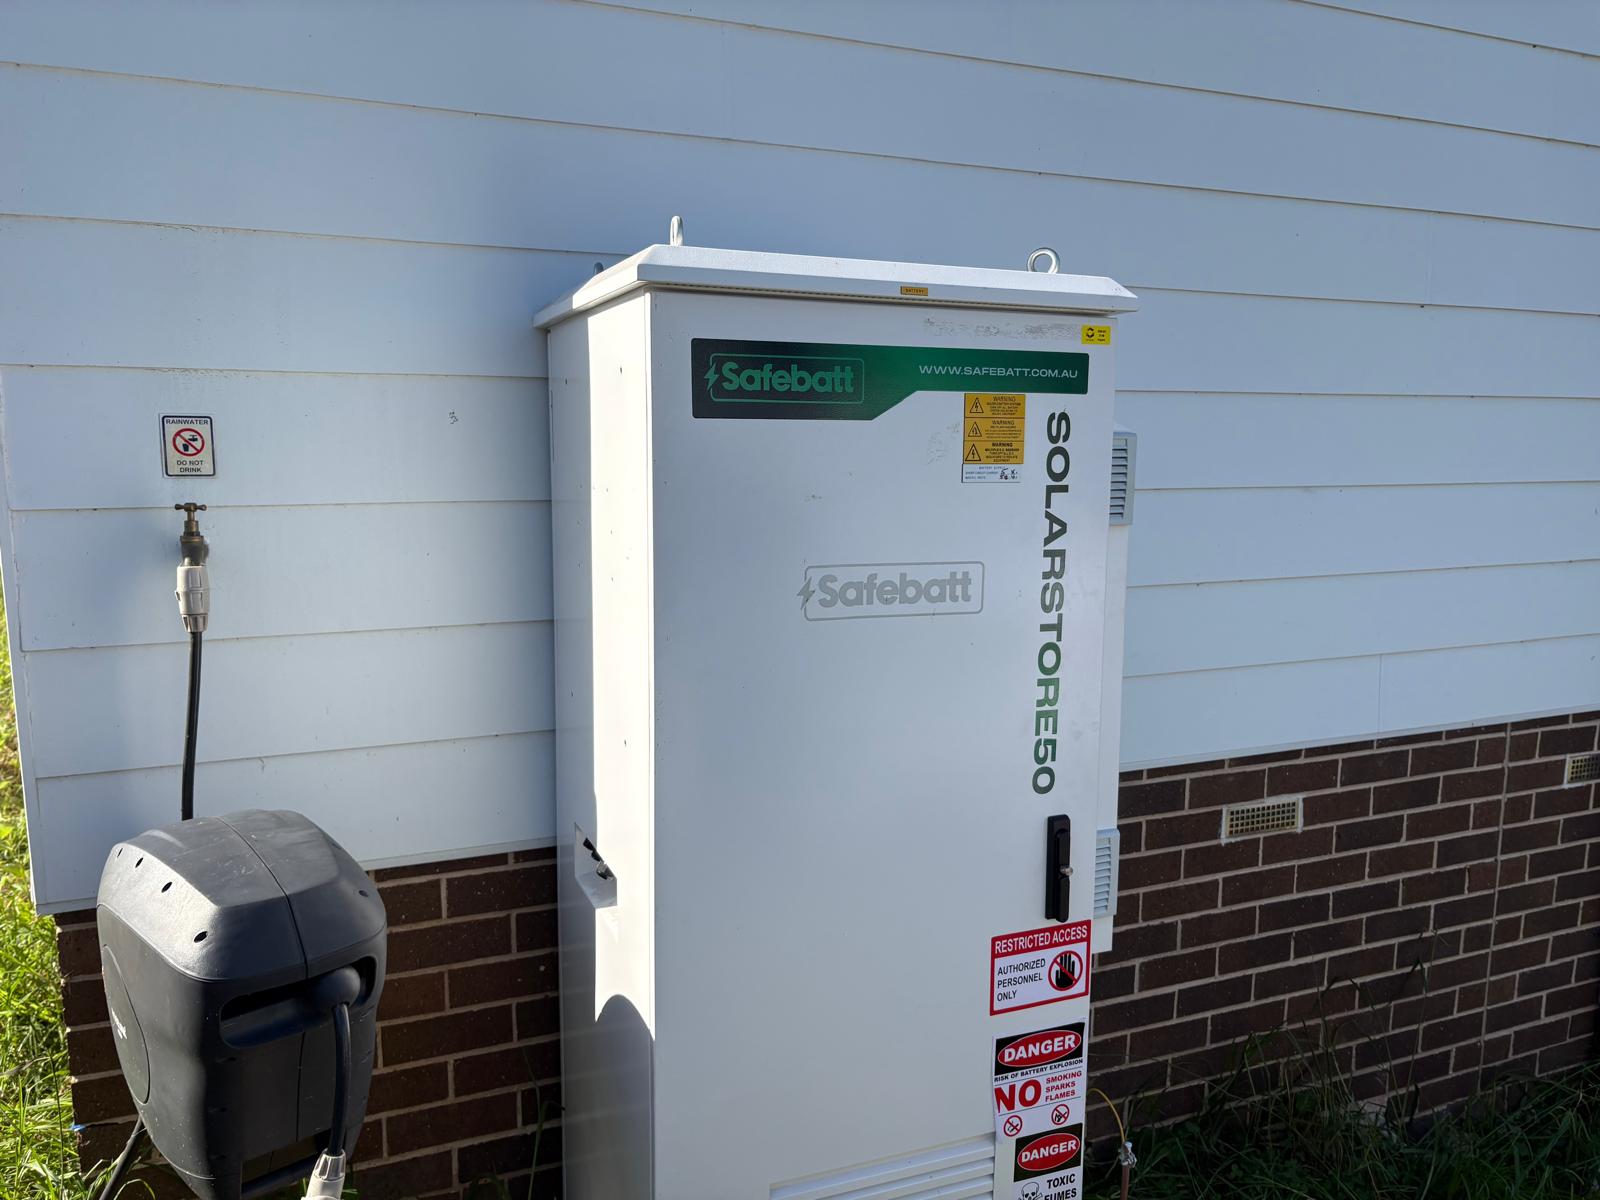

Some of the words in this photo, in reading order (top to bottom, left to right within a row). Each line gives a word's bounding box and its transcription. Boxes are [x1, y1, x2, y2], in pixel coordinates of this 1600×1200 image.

[721, 361, 854, 393] Safebatt
[919, 365, 1078, 379] WWW.SAFEBATT.COM.AU
[817, 571, 972, 608] Safebatt
[1032, 411, 1071, 795] SOLARSTORE50
[994, 931, 1051, 954] RESTRICTED
[1052, 925, 1088, 944] ACCESS
[997, 958, 1046, 976] AUTHORIZED
[997, 972, 1043, 989] PERSONNEL
[997, 989, 1017, 1002] ONLY
[1004, 1034, 1076, 1063] DANGER
[1020, 1066, 1048, 1076] BATTERY
[1049, 1058, 1083, 1071] EXPLOSION
[1045, 1070, 1082, 1084] SMOKING
[1045, 1080, 1076, 1093] SPARKS
[994, 1078, 1042, 1114] NO
[1045, 1090, 1076, 1102] FLAMES
[1021, 1139, 1077, 1163] DANGER
[1046, 1173, 1076, 1189] TOXIC
